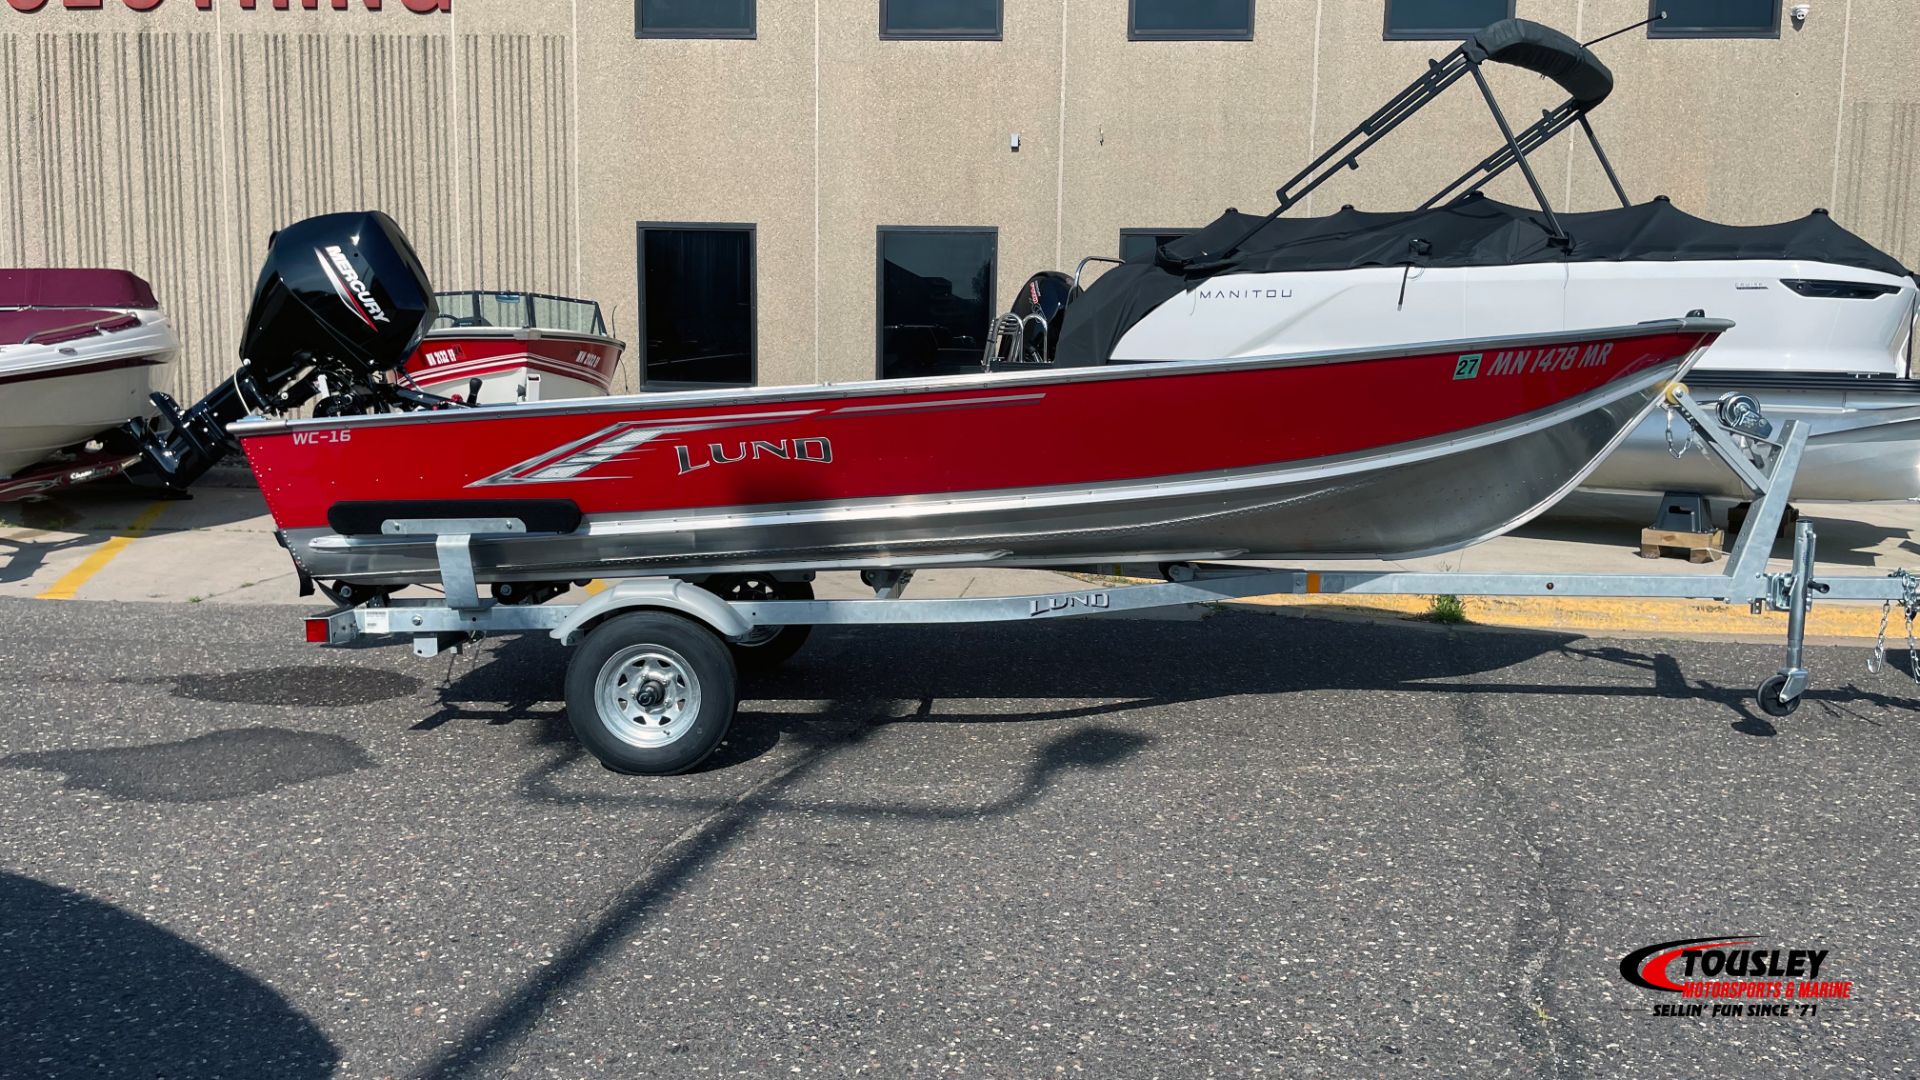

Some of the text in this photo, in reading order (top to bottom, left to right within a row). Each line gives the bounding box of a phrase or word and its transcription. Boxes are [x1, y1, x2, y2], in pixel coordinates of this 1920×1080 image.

[325, 245, 391, 323] MERCURY
[1199, 289, 1293, 299] MANITOU
[1457, 358, 1479, 376] 27
[1486, 342, 1614, 376] MN 1478 MR
[293, 430, 352, 446] WC-16
[674, 436, 833, 476] LUND
[1030, 593, 1110, 617] LUND
